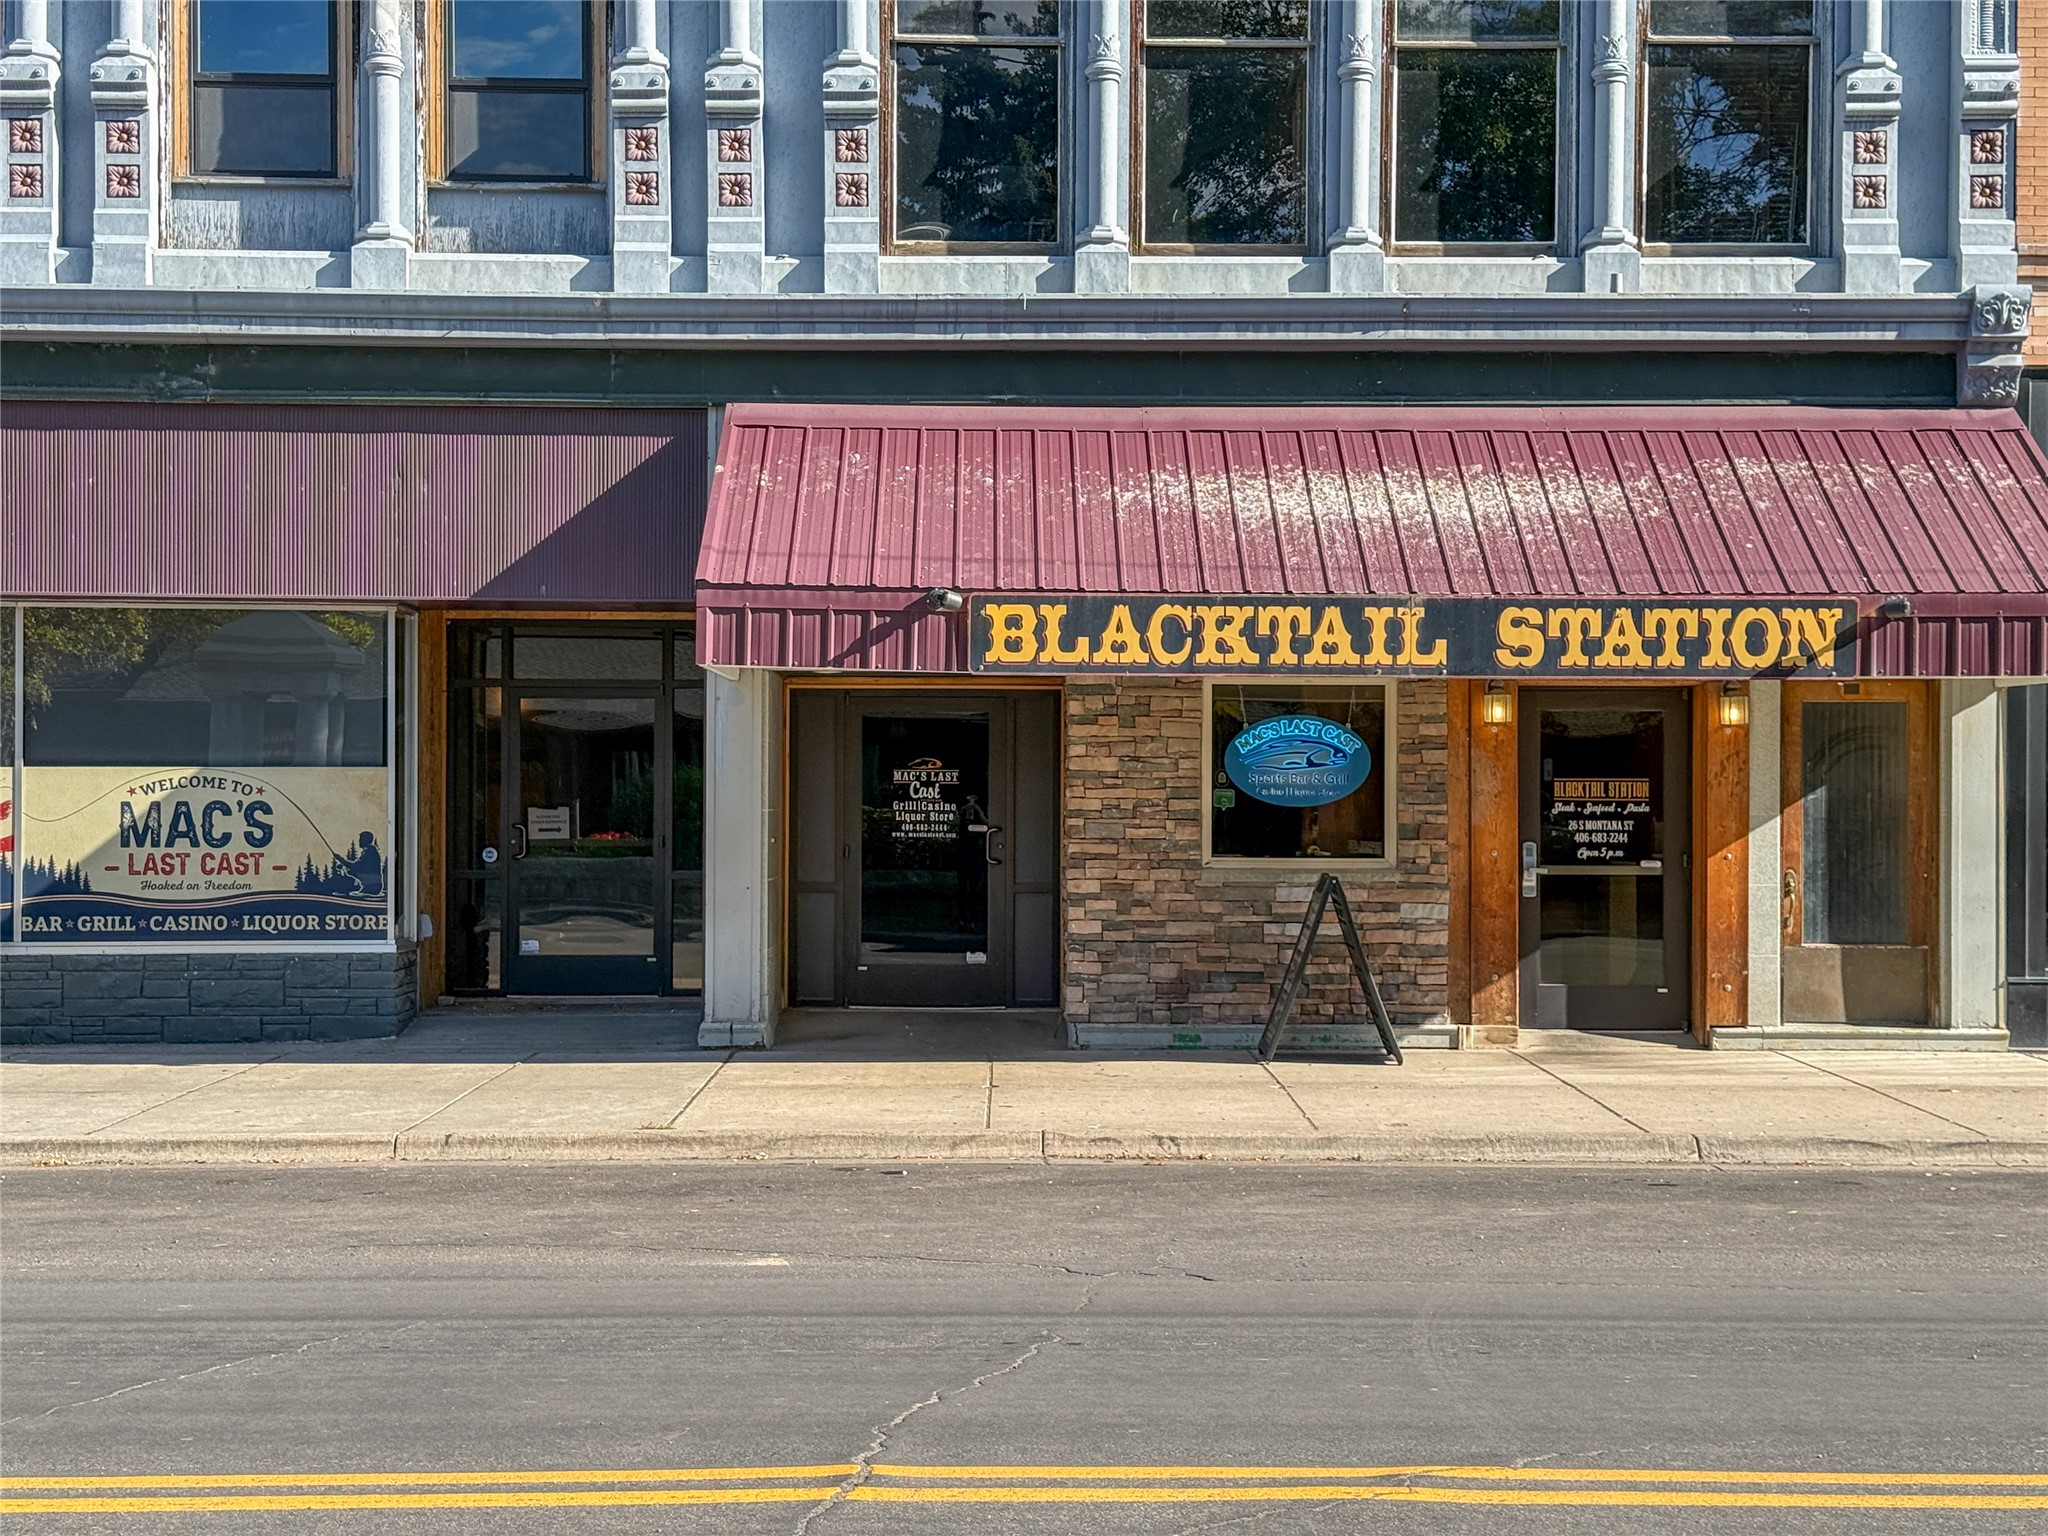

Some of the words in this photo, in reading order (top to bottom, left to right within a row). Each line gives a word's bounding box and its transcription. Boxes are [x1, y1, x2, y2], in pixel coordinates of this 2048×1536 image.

[982, 603, 1448, 667] BLACKTAIL
[1494, 606, 1843, 670] STATION
[1281, 719, 1322, 737] LAST
[1321, 725, 1362, 754] CAST
[893, 771, 927, 781] MAC'S
[930, 771, 959, 781] LAST
[1249, 772, 1287, 786] Sports
[1288, 773, 1310, 784] Bar
[1312, 773, 1321, 784] &
[1323, 773, 1349, 785] Grill
[138, 775, 229, 797] WELCOME
[231, 779, 254, 797] TO
[909, 781, 941, 799] Cast
[1553, 782, 1606, 798] BLACKTAIL
[1608, 782, 1649, 798] STATION
[921, 801, 957, 811] Casino
[1551, 802, 1576, 815] Steak
[1583, 802, 1616, 816] Seafood
[1623, 802, 1651, 815] Pasta
[895, 811, 926, 822] Liquor
[929, 812, 954, 821] Store
[118, 799, 275, 850] MAC'S
[1568, 820, 1578, 831] 26
[1578, 820, 1585, 831] S
[1585, 820, 1622, 831] MONTANA
[1623, 820, 1634, 831] ST
[1574, 832, 1628, 843] 406-683-2244
[1577, 846, 1600, 860] Open
[1599, 847, 1608, 858] 5
[128, 852, 192, 876] LAST
[200, 852, 264, 876] CAST
[139, 880, 181, 892] Hooked
[185, 882, 200, 891] on
[203, 880, 253, 891] Freedom
[21, 916, 64, 933] BAR
[77, 915, 136, 932] GRILL
[149, 915, 228, 932] CASINO
[242, 914, 321, 935] LIQUOR
[324, 914, 388, 931] STORE
